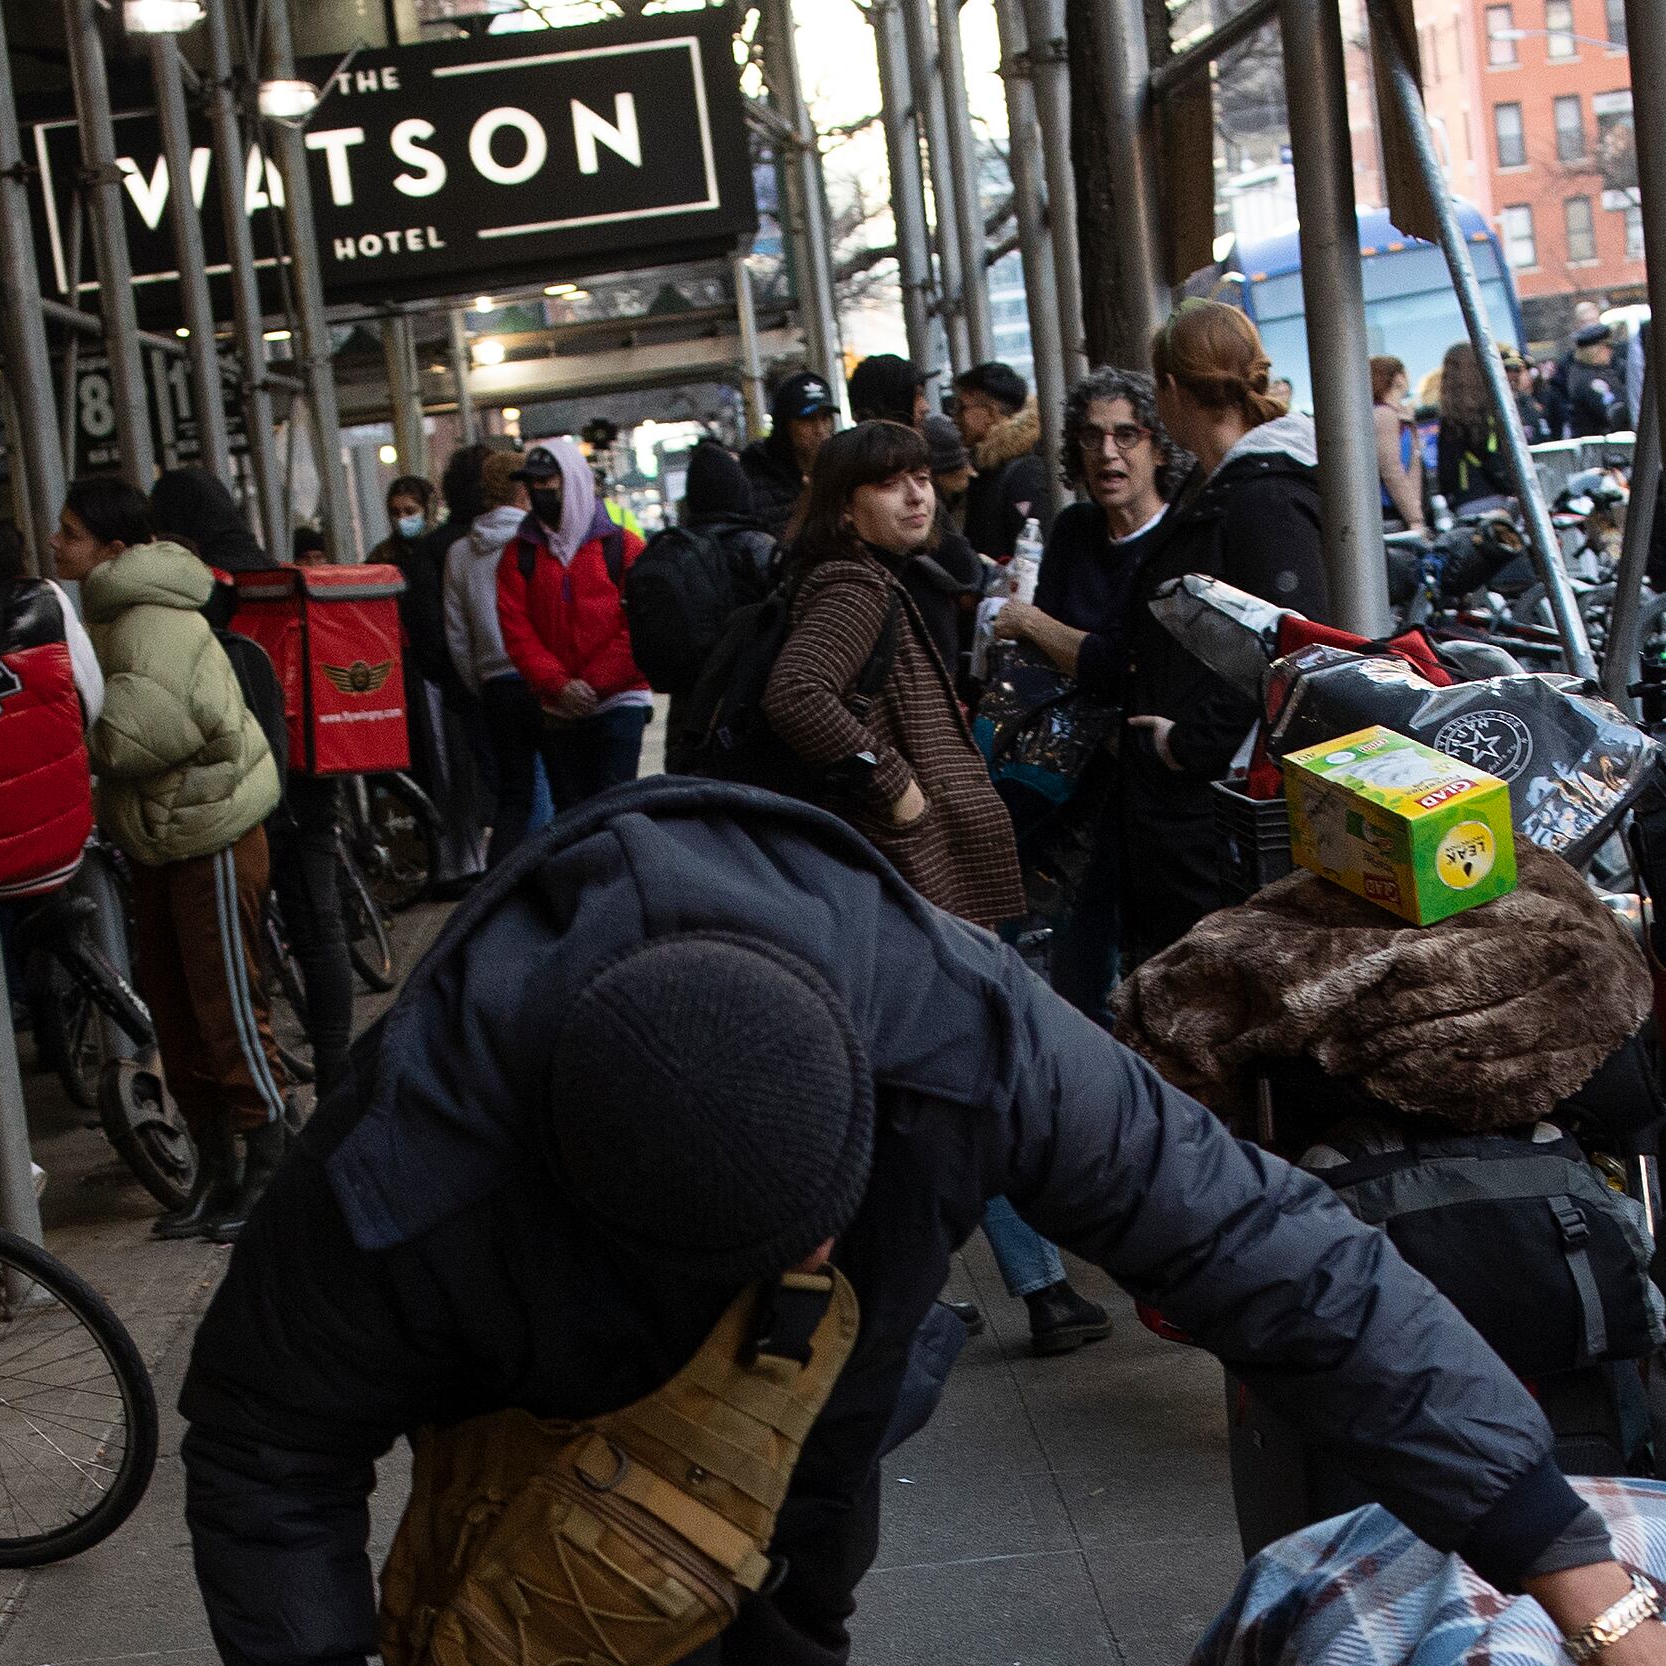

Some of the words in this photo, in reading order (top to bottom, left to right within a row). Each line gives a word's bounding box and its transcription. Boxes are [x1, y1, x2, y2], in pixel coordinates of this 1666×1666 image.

[334, 66, 400, 95] THE
[115, 92, 642, 230] WATSON
[334, 226, 445, 260] HOTEL
[1419, 779, 1475, 809] GLAD
[1444, 840, 1487, 866] LEAK
